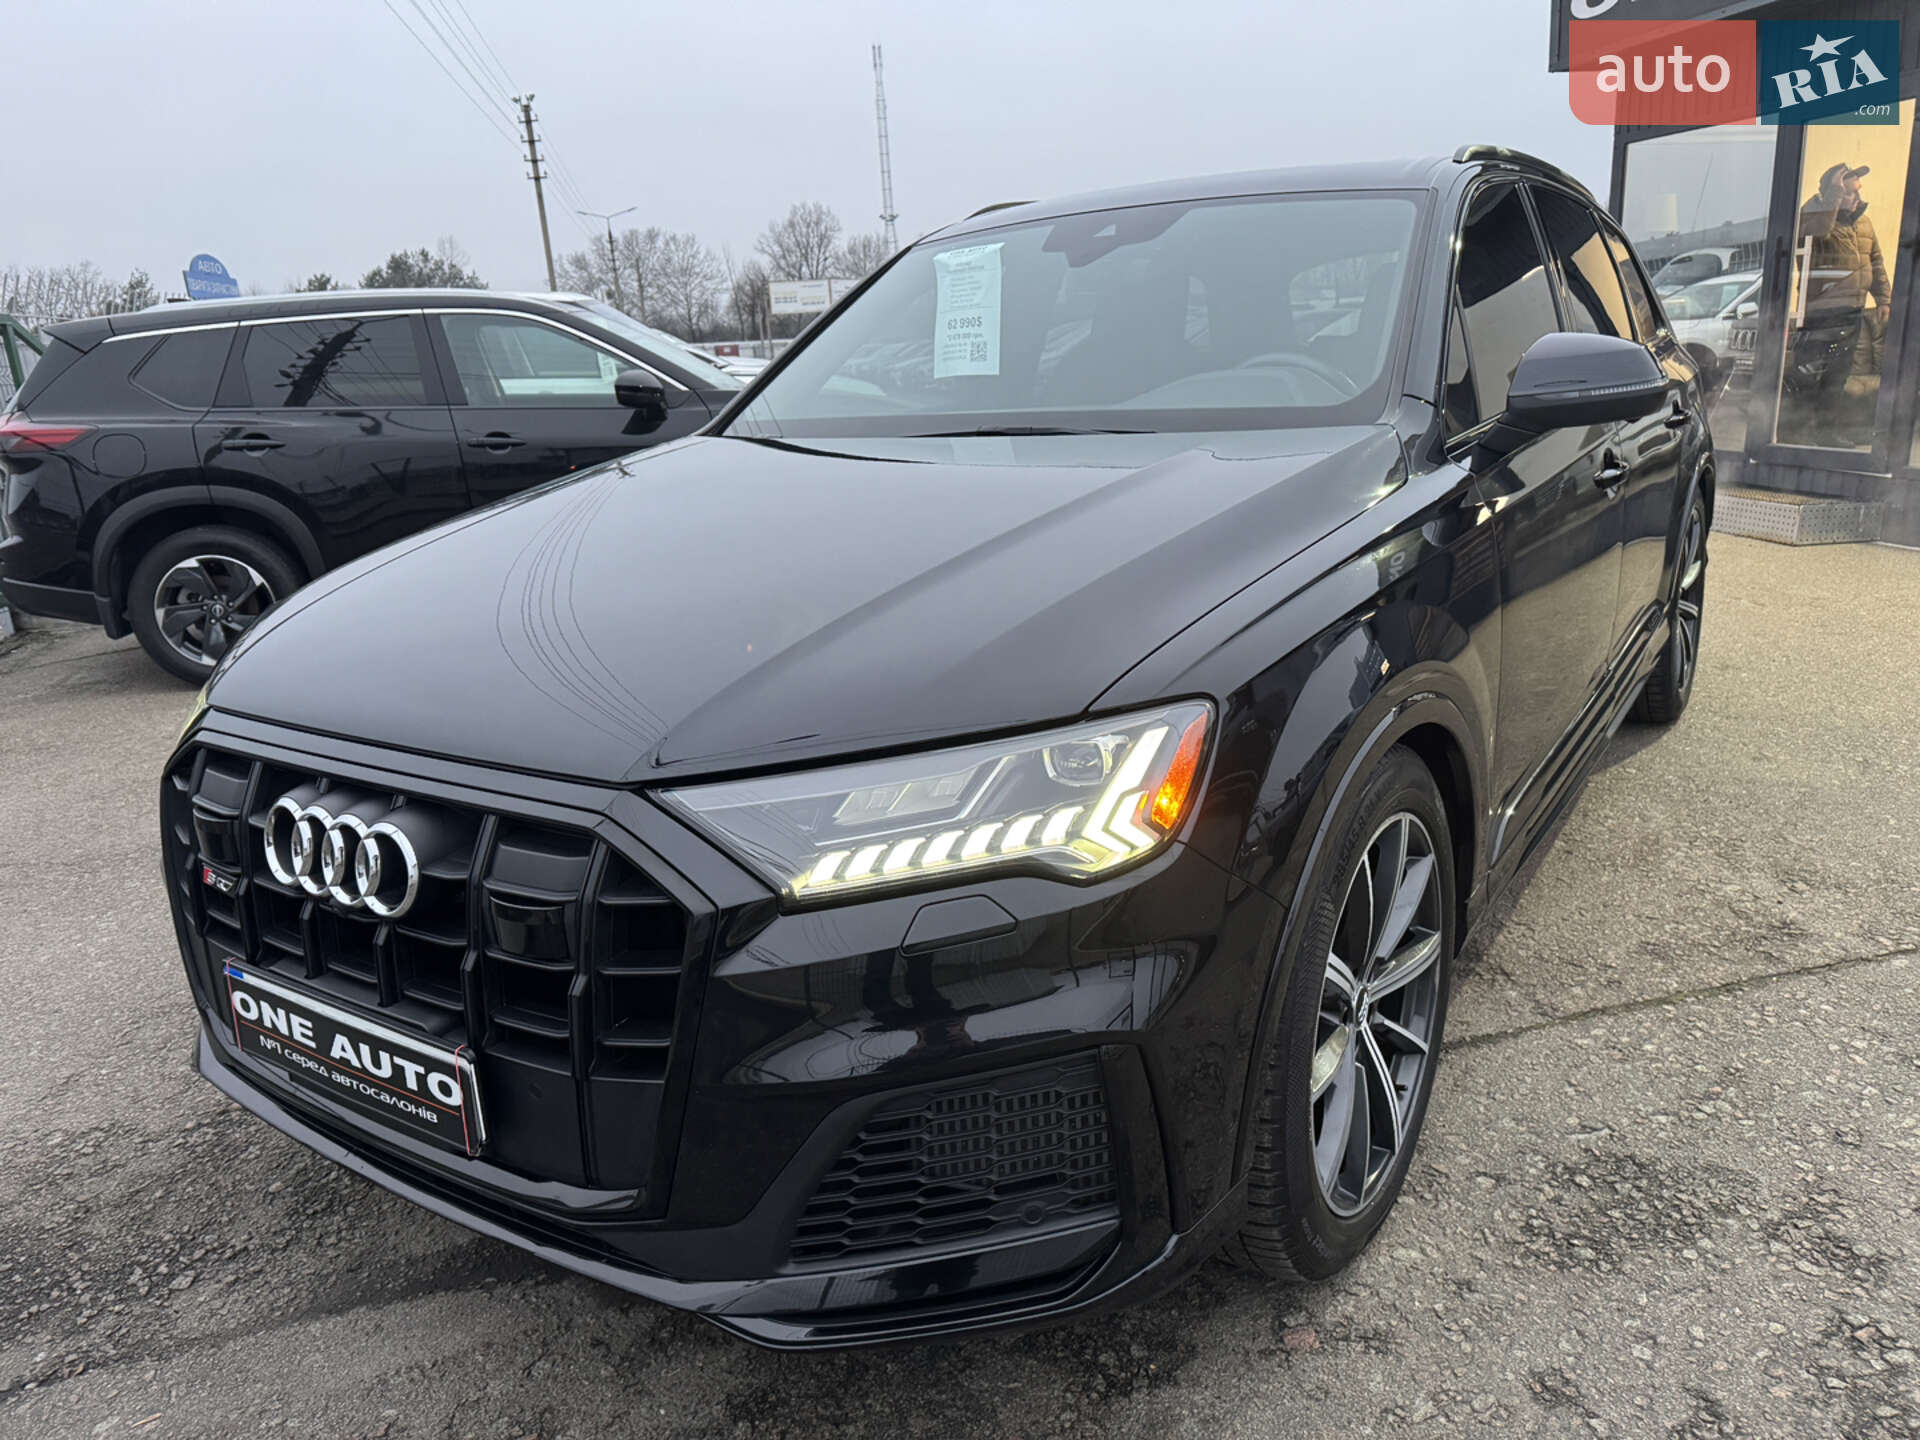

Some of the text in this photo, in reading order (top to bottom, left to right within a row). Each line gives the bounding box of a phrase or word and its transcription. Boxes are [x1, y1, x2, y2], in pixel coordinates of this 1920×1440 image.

[198, 260, 222, 275] АВТО
[947, 317, 958, 330] 62
[231, 990, 464, 1107] ONE AUTO
[284, 1047, 329, 1077] серед
[331, 1071, 438, 1124] автосалонів
